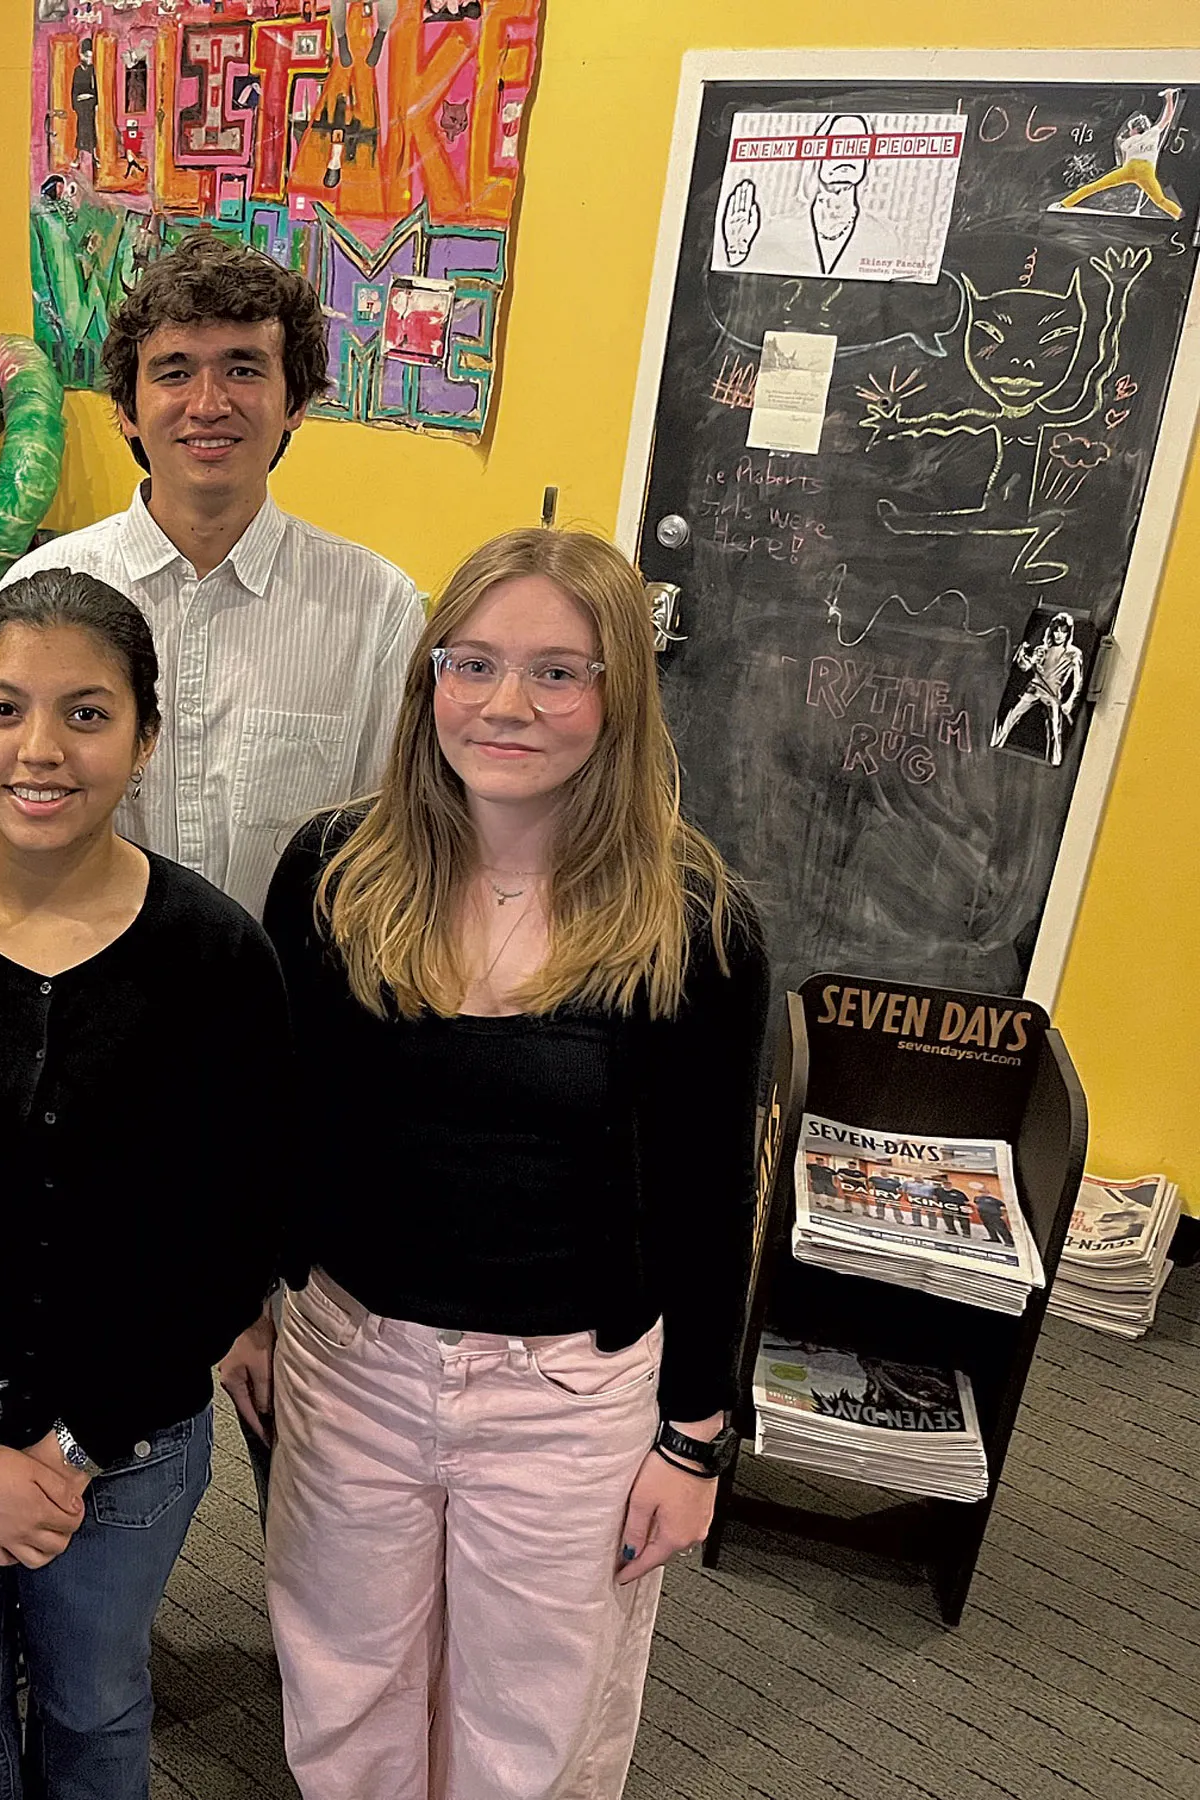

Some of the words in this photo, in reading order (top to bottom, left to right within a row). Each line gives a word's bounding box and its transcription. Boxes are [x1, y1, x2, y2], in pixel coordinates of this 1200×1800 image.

[738, 140, 796, 157] ENEMY
[803, 140, 827, 155] OF
[834, 139, 869, 154] THE
[877, 138, 954, 154] PEOPLE
[842, 722, 937, 785] RUG
[817, 984, 931, 1037] SEVEN
[939, 1001, 1032, 1052] DAYS
[897, 1039, 1022, 1067] sevendaysvt.com
[840, 1182, 902, 1201] DAIRY
[908, 1196, 974, 1214] KINGS
